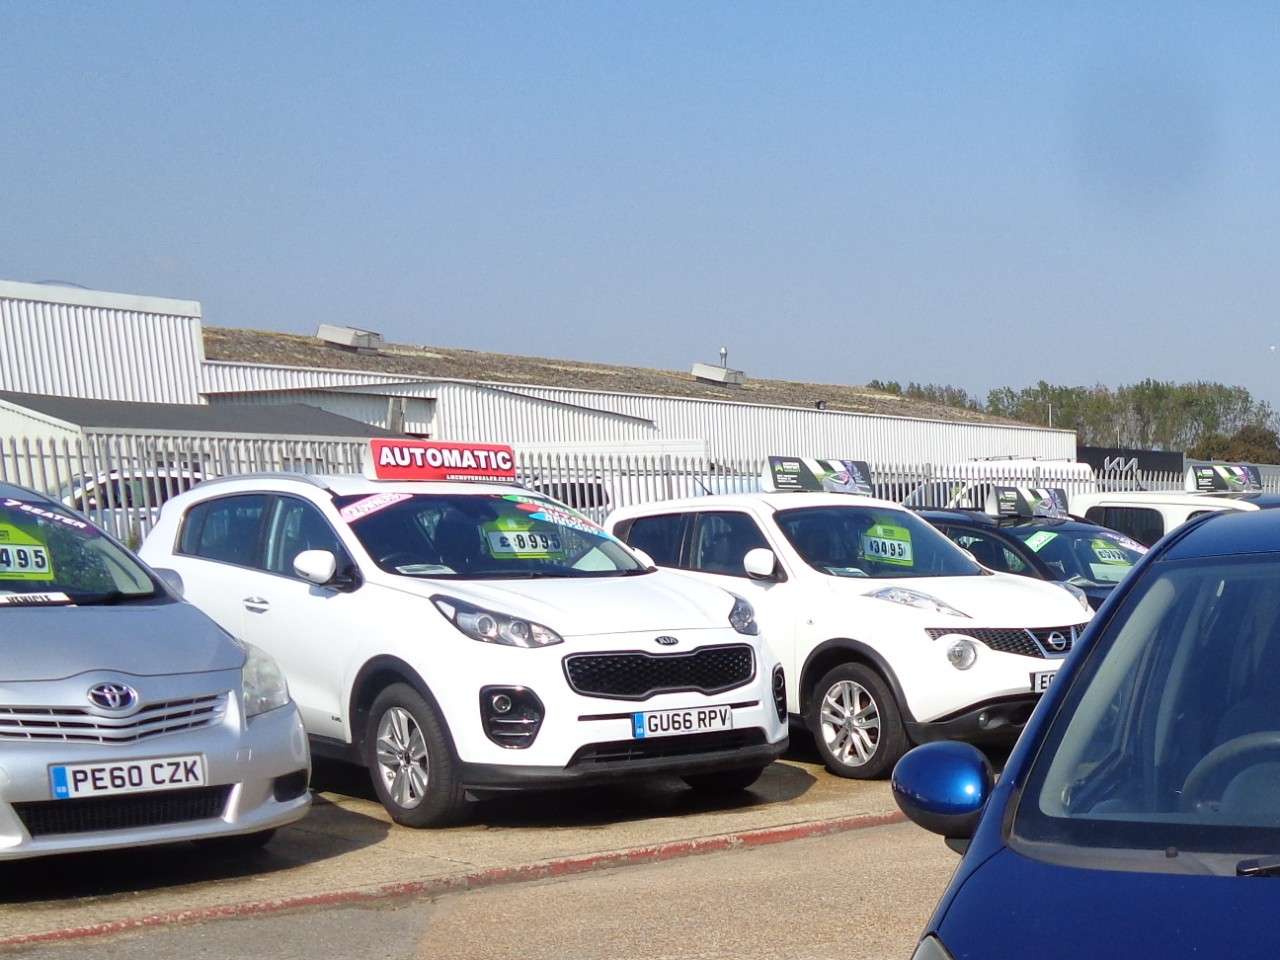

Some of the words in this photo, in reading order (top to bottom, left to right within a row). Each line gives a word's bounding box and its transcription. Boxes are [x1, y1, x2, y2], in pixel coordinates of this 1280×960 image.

[379, 446, 513, 471] AUTOMATIC
[20, 504, 88, 529] SEATER
[647, 711, 693, 733] GU66
[697, 708, 728, 729] RPV
[71, 764, 145, 793] PE60
[150, 759, 200, 786] CZK
